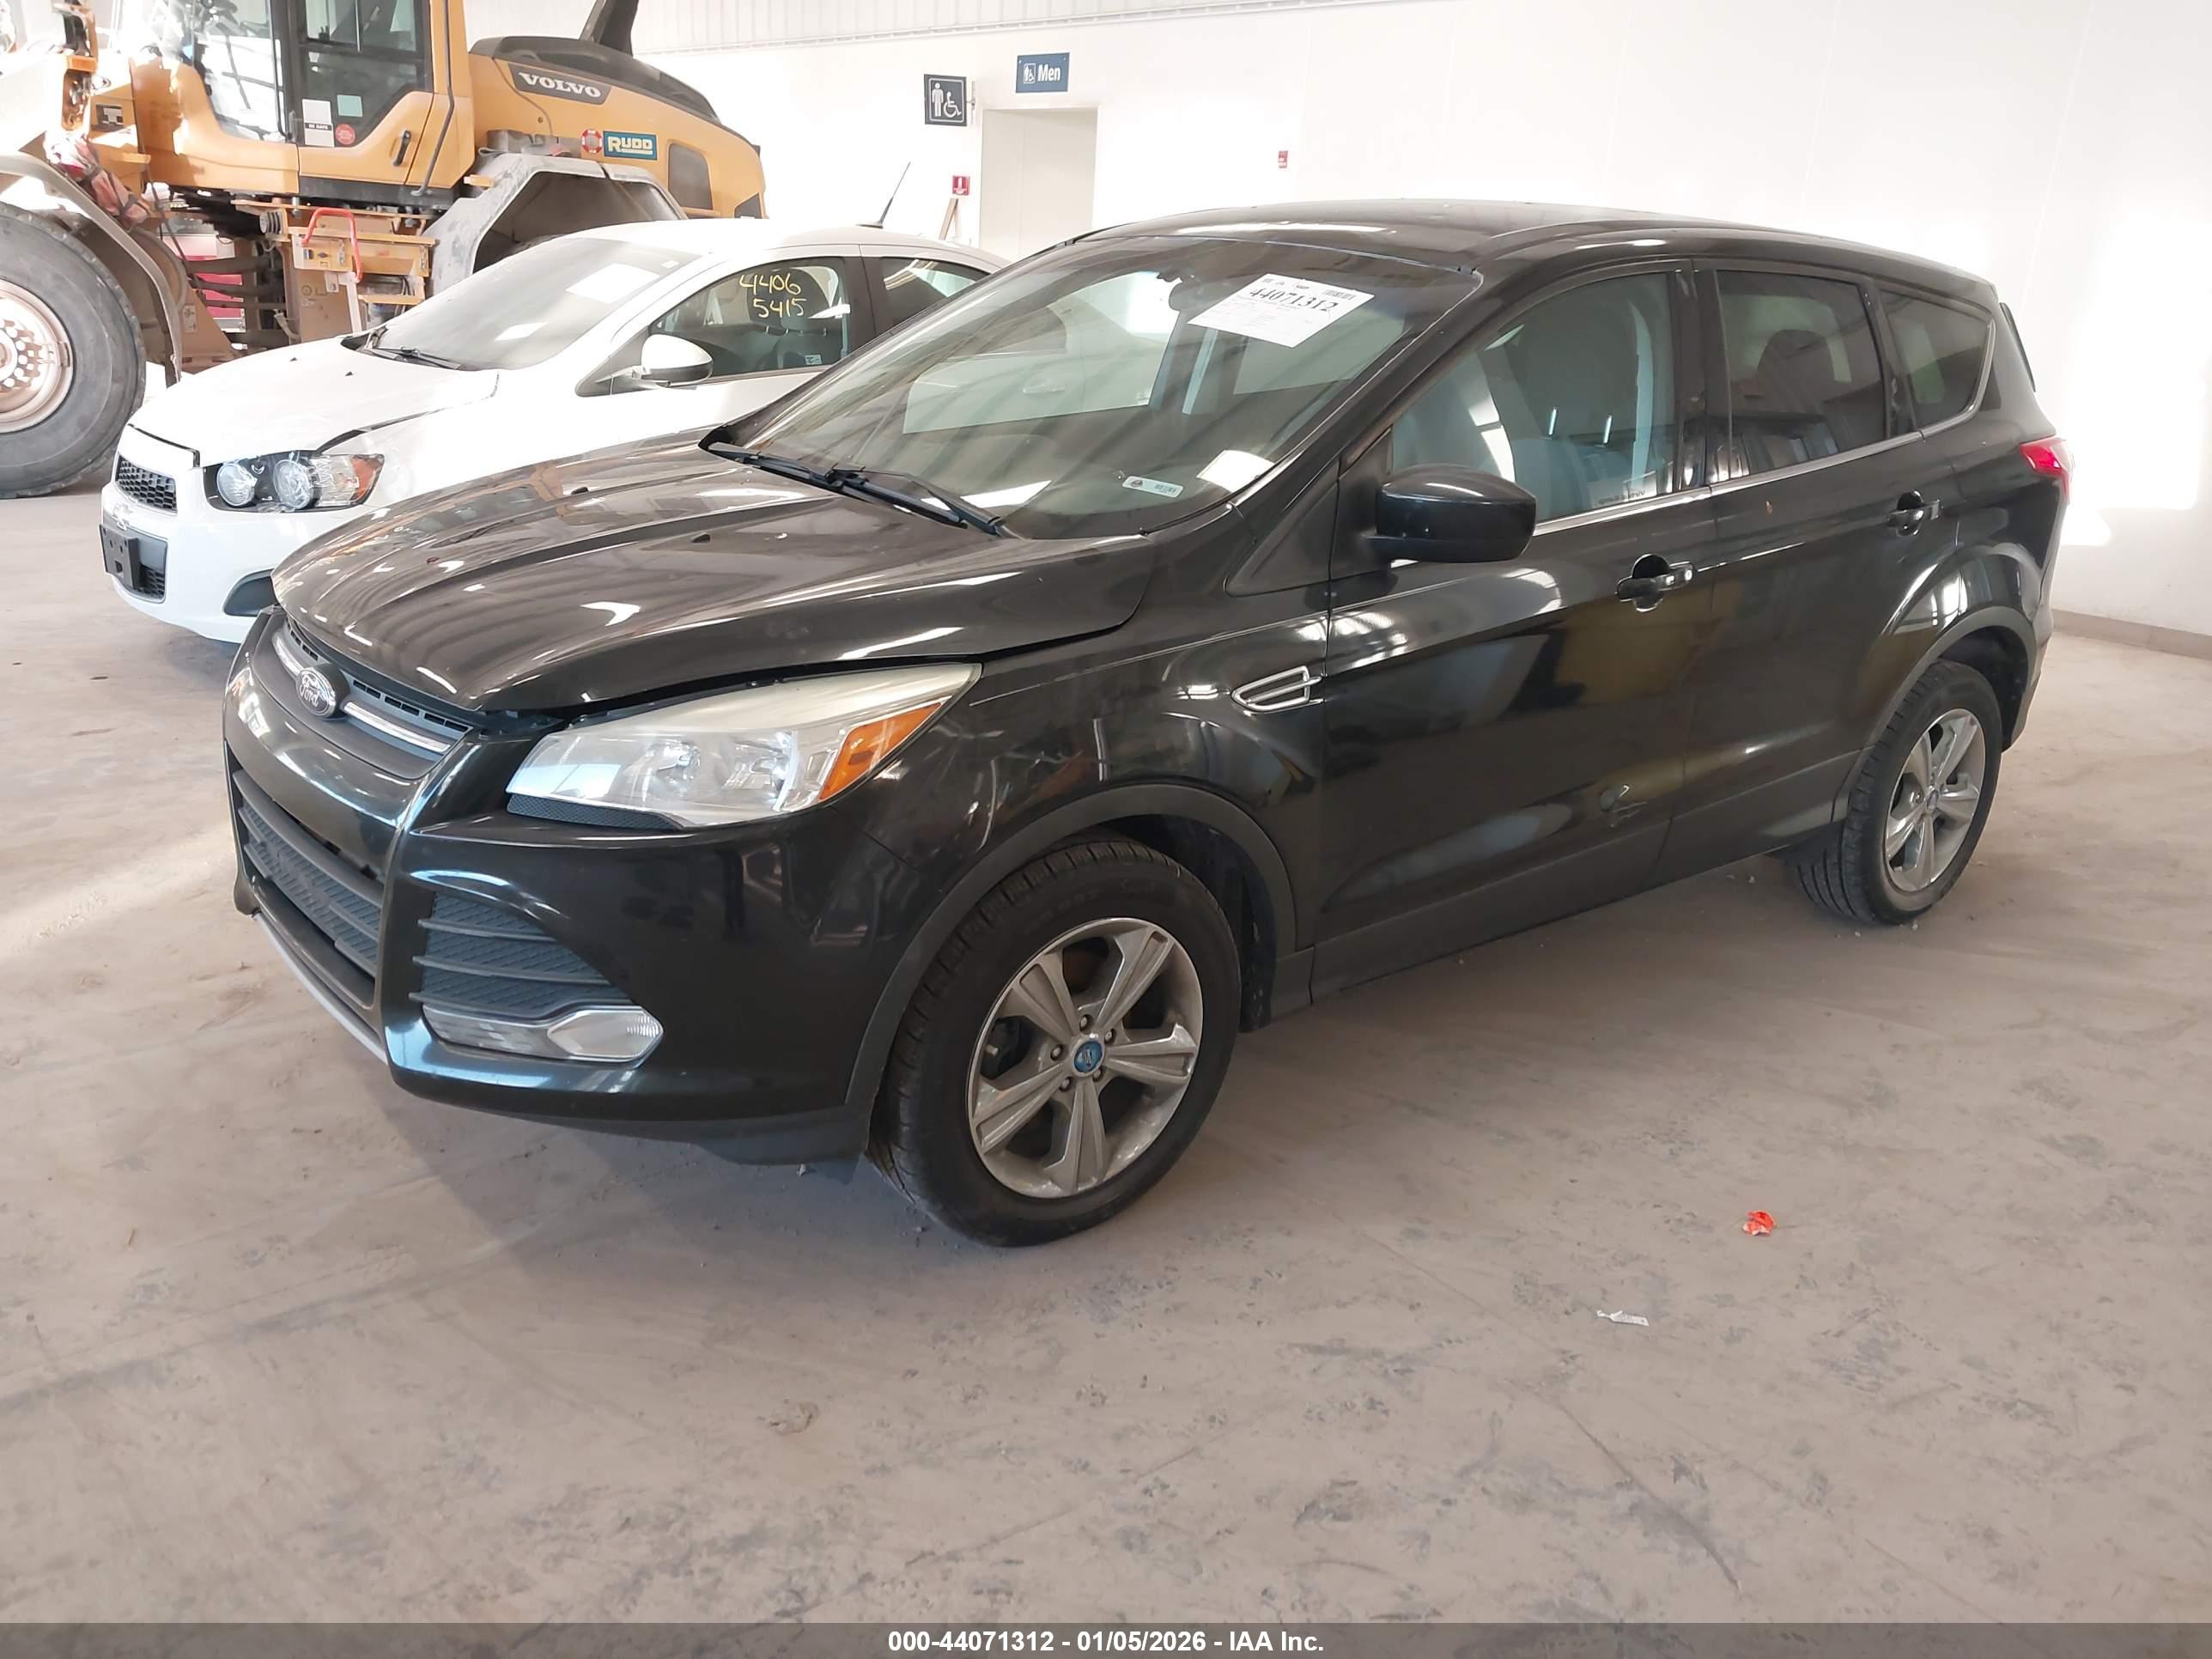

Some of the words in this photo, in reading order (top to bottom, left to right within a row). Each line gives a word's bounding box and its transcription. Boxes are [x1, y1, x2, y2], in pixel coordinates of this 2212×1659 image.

[1037, 64, 1061, 82] Men
[518, 72, 601, 98] VOLVO
[608, 136, 653, 154] RUDD
[739, 273, 801, 295] 4406
[753, 298, 807, 319] 5415
[1249, 288, 1339, 312] 44071312
[299, 674, 321, 708] Ford
